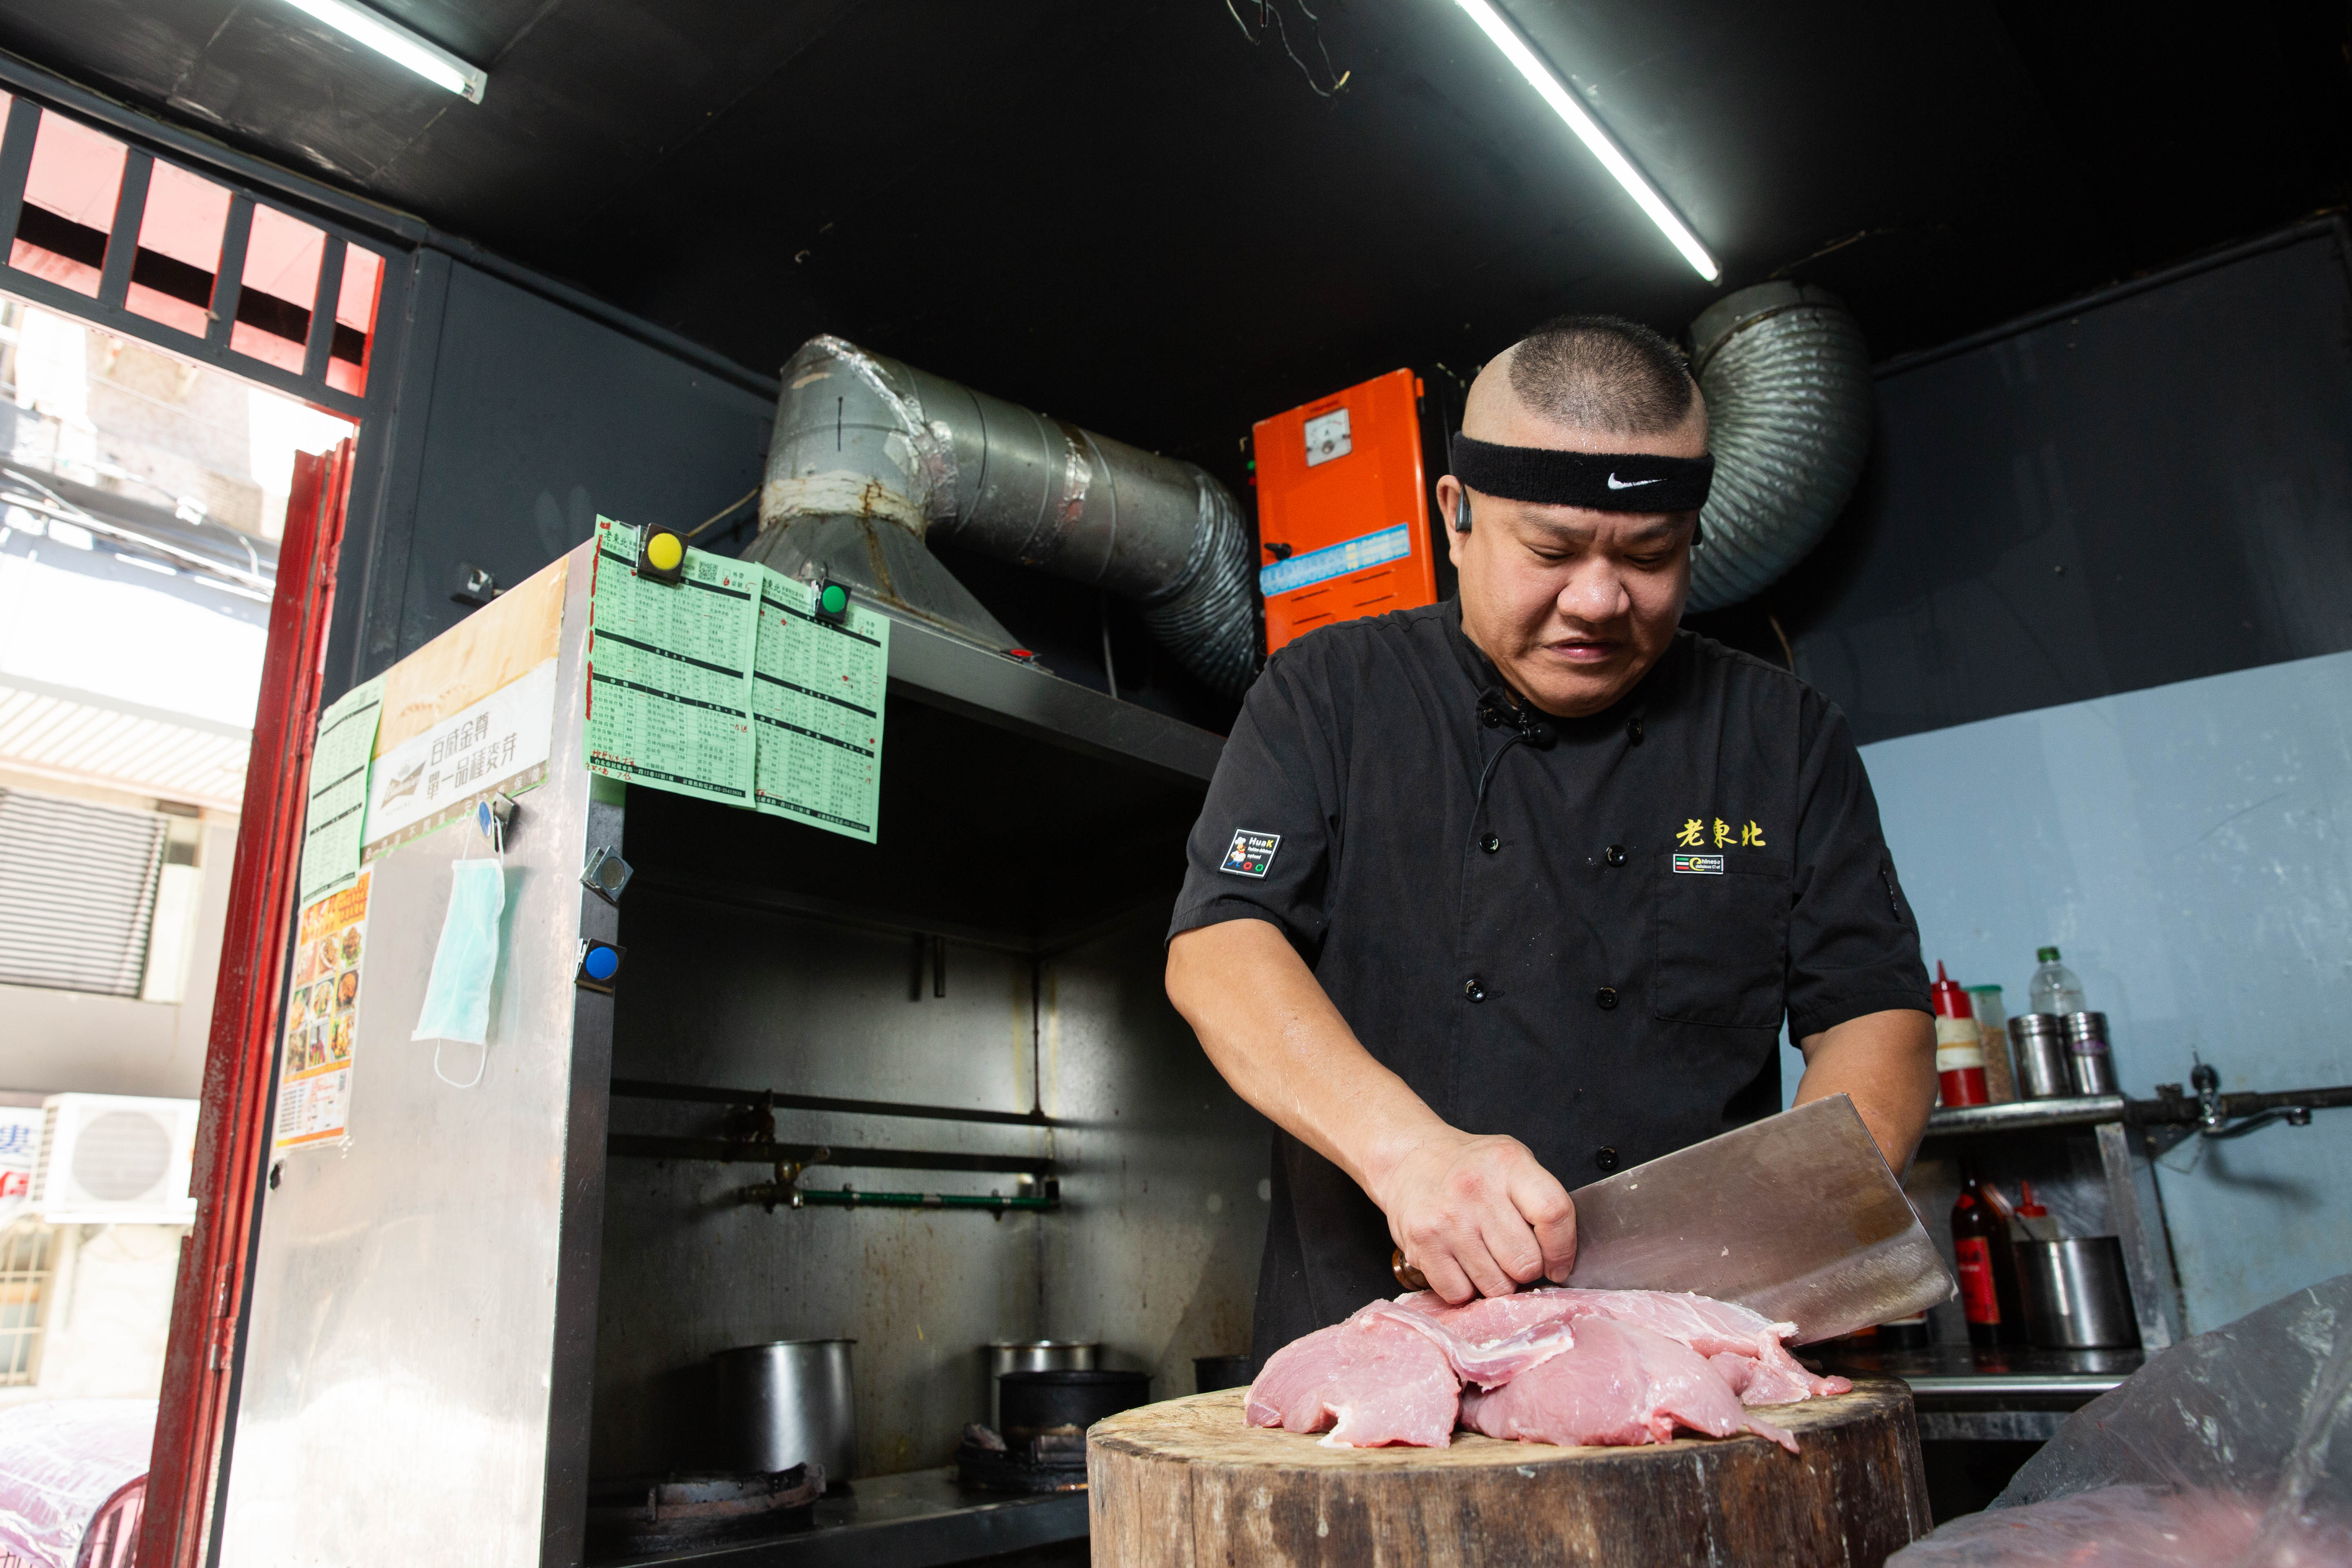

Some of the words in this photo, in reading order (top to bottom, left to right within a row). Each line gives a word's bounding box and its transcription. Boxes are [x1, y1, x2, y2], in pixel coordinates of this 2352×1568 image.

[604, 530, 628, 548] 老東北
[431, 711, 490, 766] 百威金尊
[426, 732, 518, 800] 單一品種麥芽
[1249, 837, 1274, 849] HuaK
[1676, 817, 1766, 849] 老東北
[1689, 857, 1721, 871] Chinese
